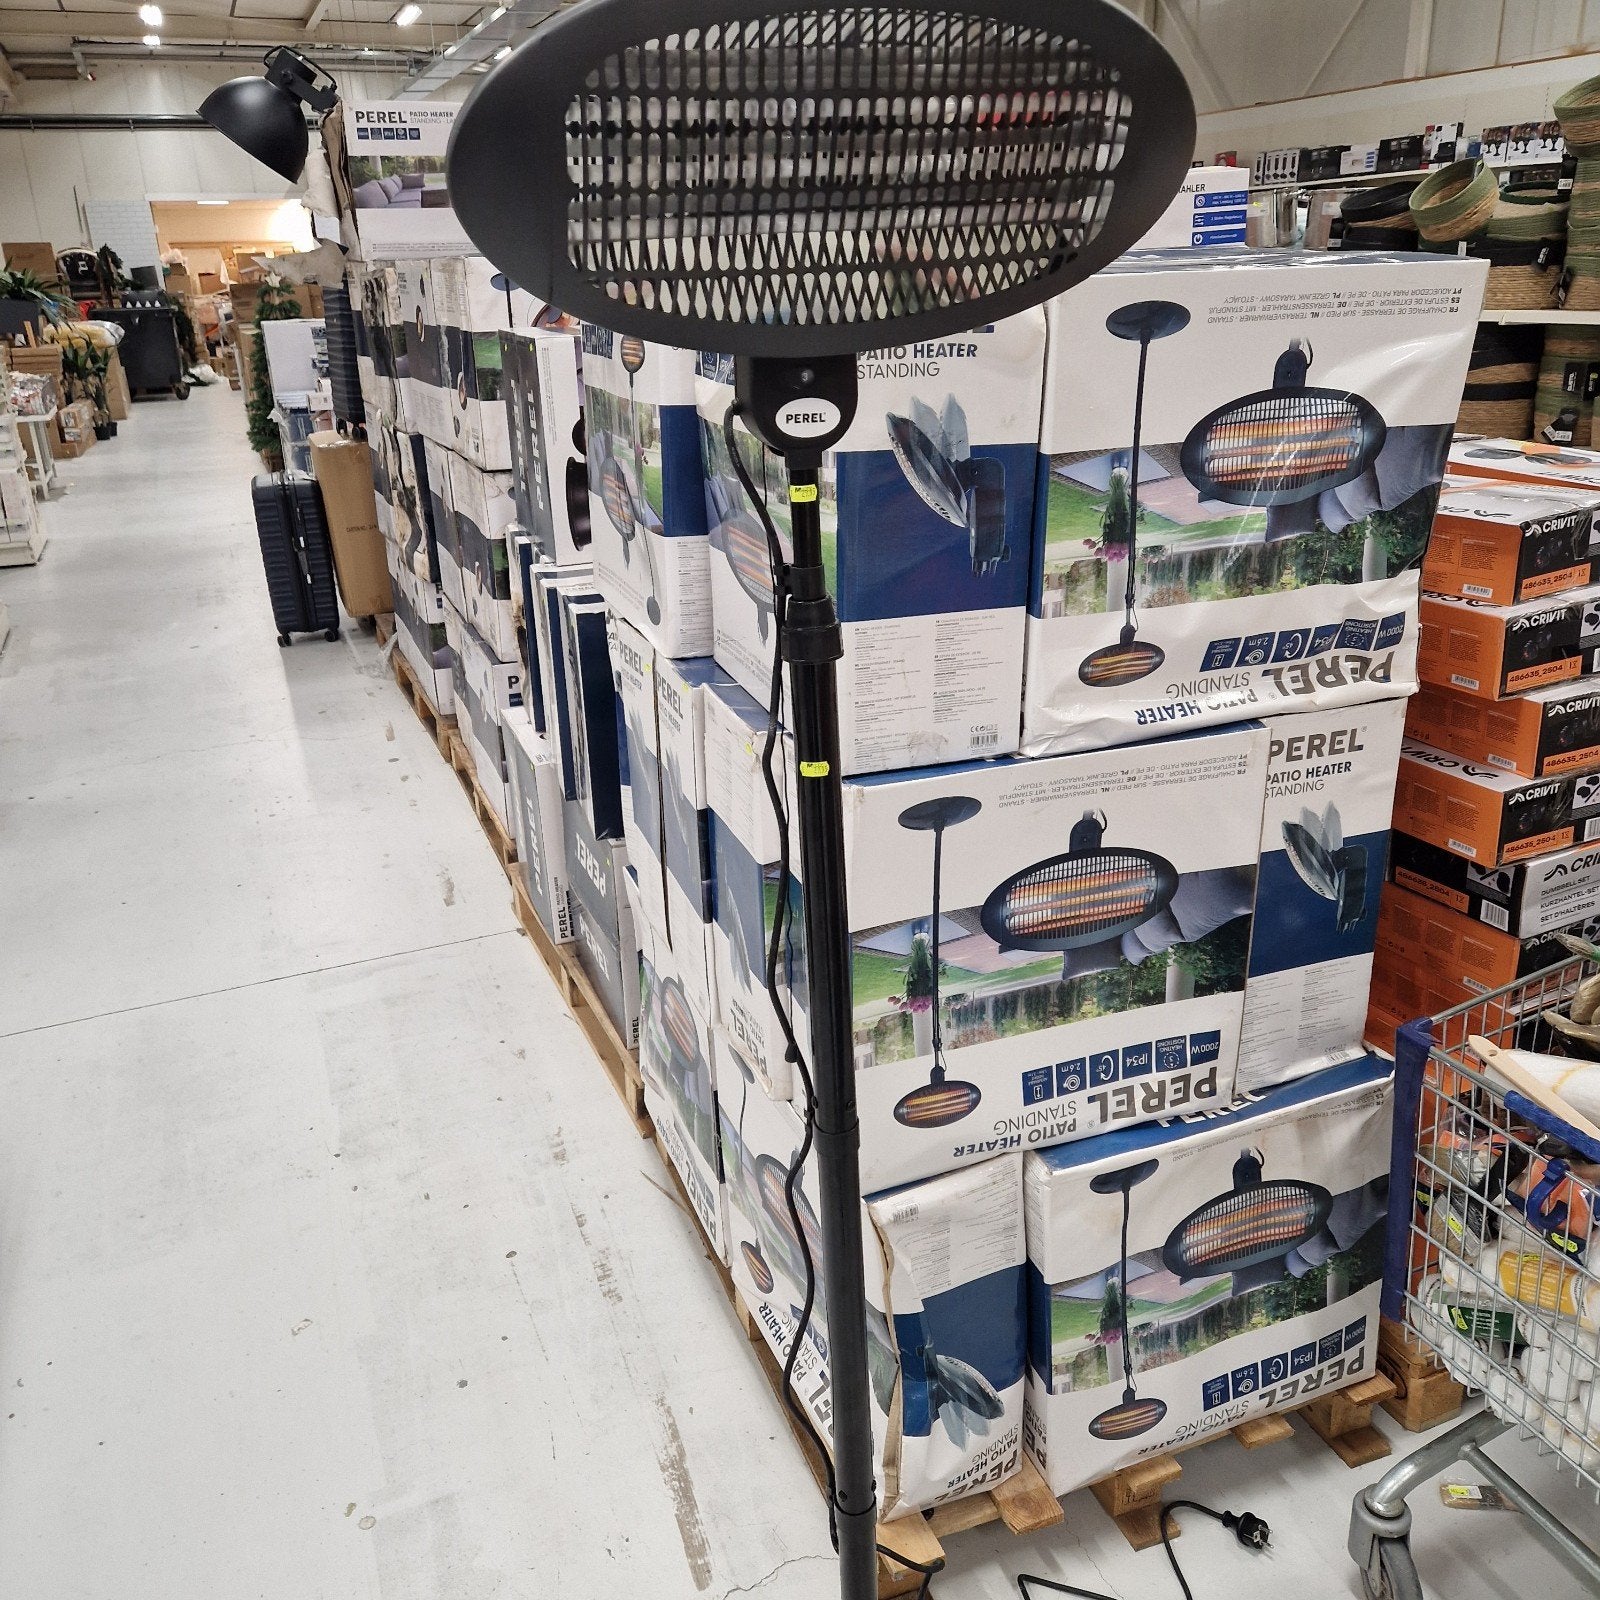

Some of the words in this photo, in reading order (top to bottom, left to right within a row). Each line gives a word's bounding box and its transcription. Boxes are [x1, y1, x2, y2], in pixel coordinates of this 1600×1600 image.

[355, 110, 408, 124] PEREL
[1179, 183, 1206, 194] AHLER
[1342, 310, 1356, 318] SUR
[1361, 308, 1396, 316] TERRASSE
[1408, 306, 1448, 315] CHAUFFAGE
[913, 343, 978, 359] HEATER
[857, 361, 940, 380] STANDING
[786, 412, 826, 424] PEREL
[1543, 515, 1578, 533] CRIVIT
[1530, 608, 1568, 627] CRIVIT
[1262, 651, 1396, 697] PEREL
[1510, 664, 1563, 683] 486635_2504
[1166, 672, 1251, 700] STANDING
[1135, 701, 1200, 726] HEATER
[1268, 728, 1365, 766] PEREL
[1545, 750, 1599, 768] 486635_2504
[1306, 761, 1352, 779] HEATER
[1152, 777, 1186, 787] TERRASSE
[1264, 780, 1325, 799] STANDING
[1525, 782, 1561, 801] CRIVIT
[574, 832, 608, 898] PEREL
[1541, 880, 1578, 896] DUMBBELL
[1578, 874, 1591, 884] SET
[1540, 886, 1600, 909] KURZHANTEL-SET
[558, 906, 569, 939] PEREL
[1540, 914, 1554, 923] SET
[1156, 1038, 1186, 1048] POSITIONS
[1160, 1044, 1183, 1052] HEATING
[1126, 1054, 1148, 1068] IP34
[1088, 1066, 1218, 1124] PEREL
[994, 1100, 1077, 1136] STANDING
[1028, 1118, 1077, 1144] PATIO
[953, 1134, 1022, 1158] HEATER
[758, 1302, 787, 1346] HEATER
[782, 1342, 808, 1383] PAO
[1293, 1351, 1313, 1365] IP34
[1258, 1346, 1366, 1409] PEREL
[1175, 1400, 1250, 1436] STANDING
[1201, 1411, 1246, 1433] PATIO
[972, 1424, 1019, 1464] STANDING
[991, 1434, 1018, 1466] PATIO
[1137, 1429, 1200, 1456] HEATER
[947, 1458, 988, 1488] HEATER
